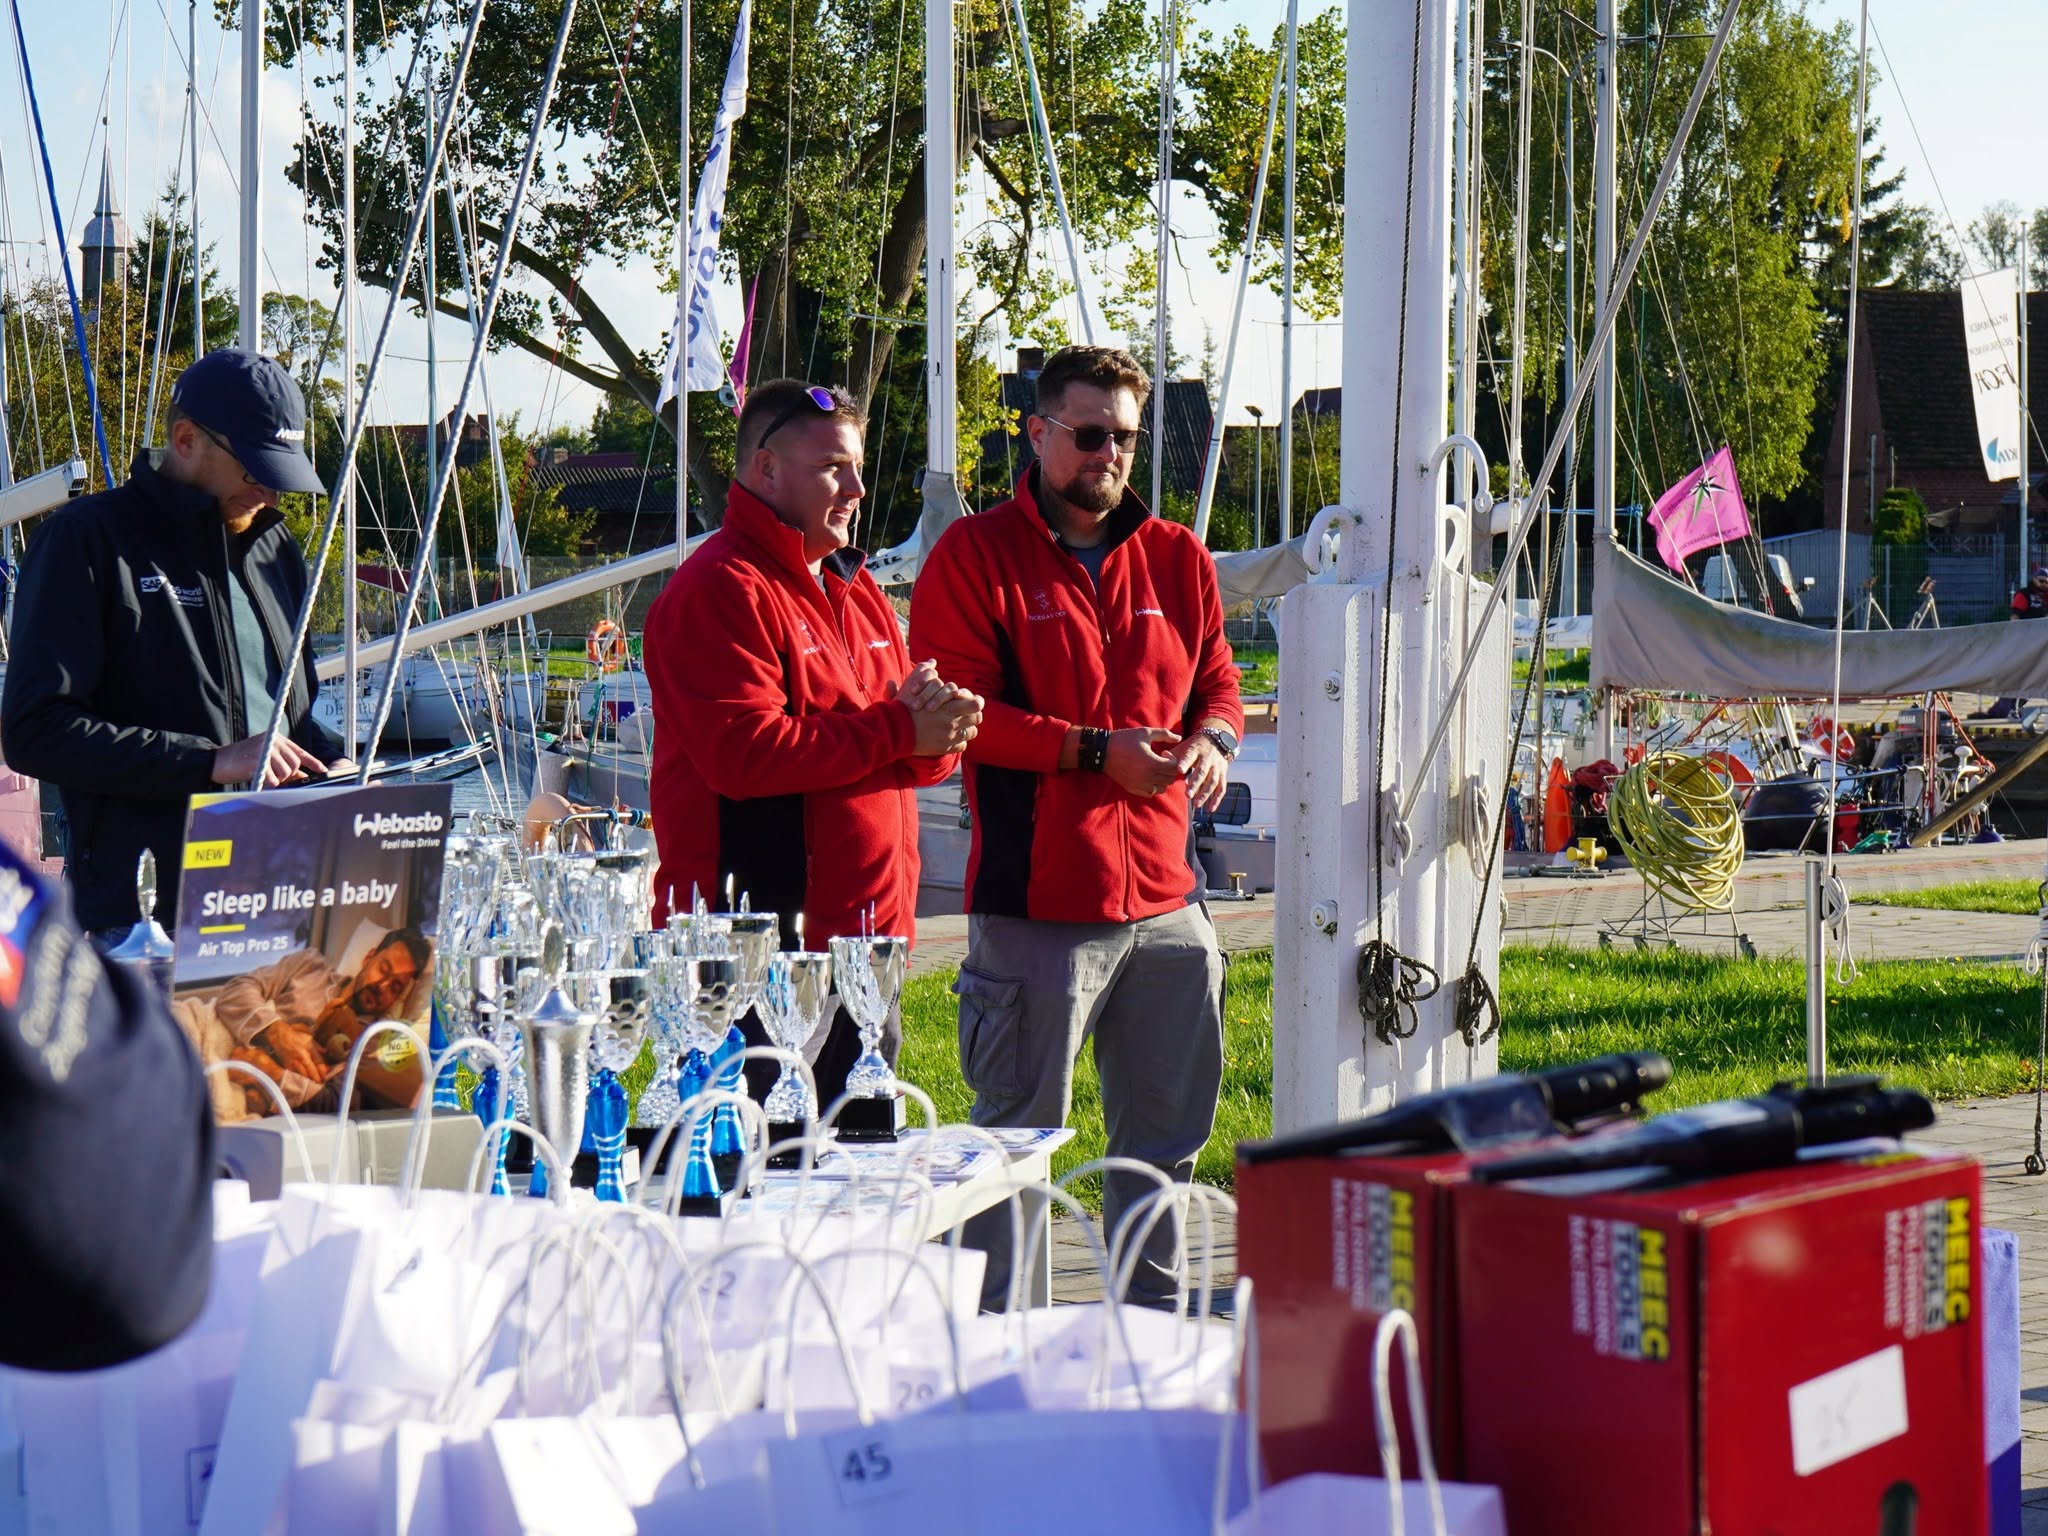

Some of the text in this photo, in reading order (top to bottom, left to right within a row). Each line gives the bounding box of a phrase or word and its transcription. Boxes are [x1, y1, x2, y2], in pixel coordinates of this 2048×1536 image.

[142, 578, 162, 590] SAP
[353, 811, 444, 837] Webasto
[381, 837, 441, 849] Feel the Drive
[194, 847, 225, 862] NEW
[202, 878, 399, 919] Sleep like a baby
[198, 935, 289, 958] Air Top Pro 25
[1371, 1192, 1390, 1307] TOOLS
[1389, 1190, 1415, 1313] MEEC
[1925, 1211, 1943, 1327] TOOLS
[1944, 1196, 1971, 1325] MEEC
[1616, 1232, 1637, 1352] TOOLS
[1638, 1227, 1671, 1362] MEEC
[841, 1441, 893, 1485] 45
